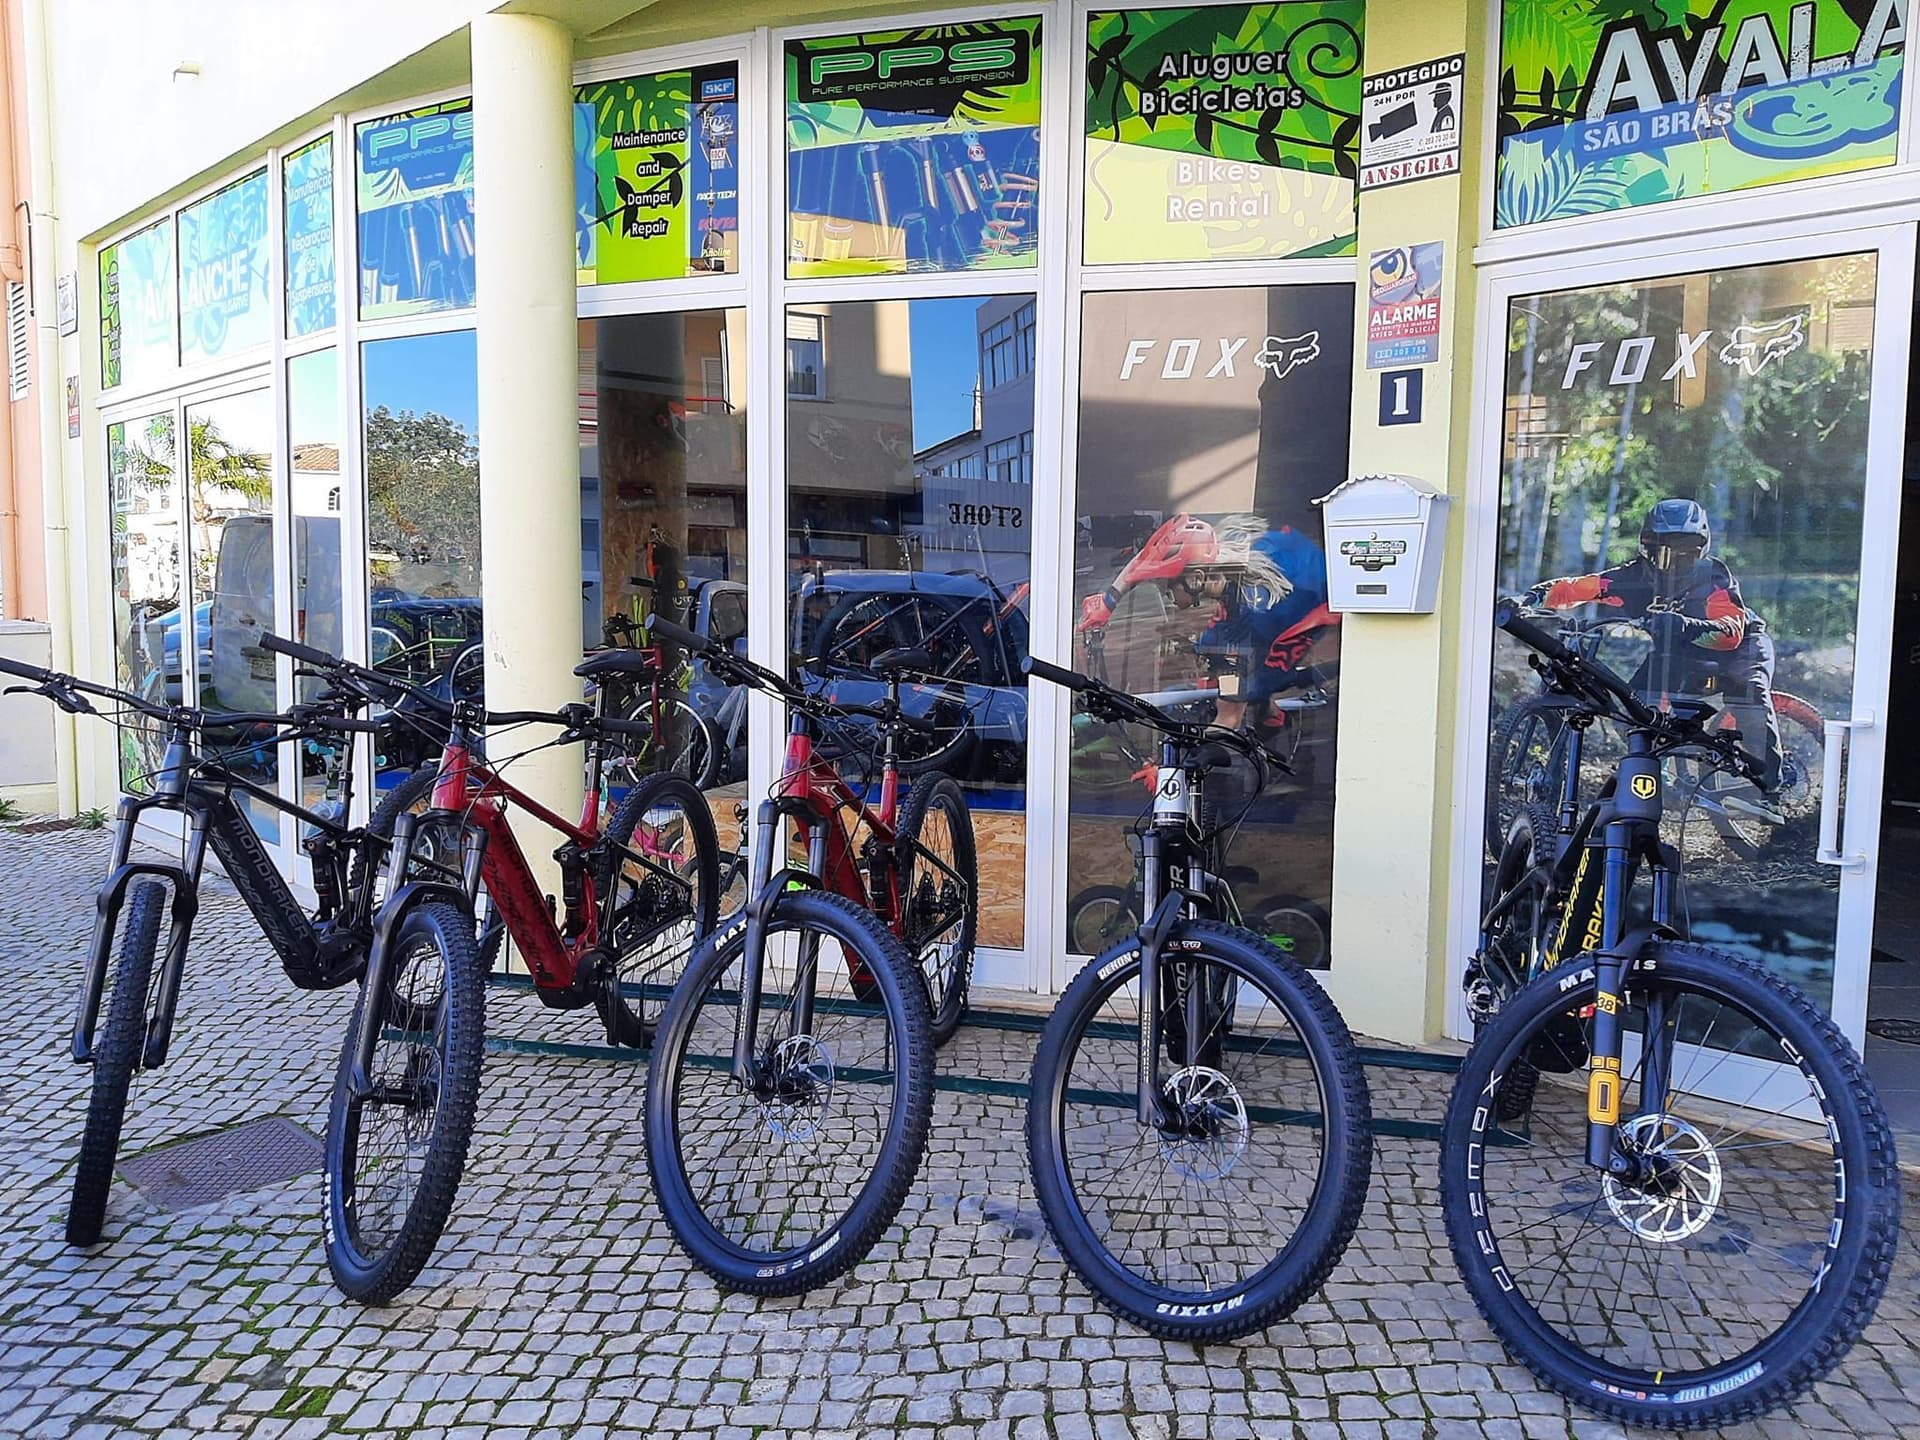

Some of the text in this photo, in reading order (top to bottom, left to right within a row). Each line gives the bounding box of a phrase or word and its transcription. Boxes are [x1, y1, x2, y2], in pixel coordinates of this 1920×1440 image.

[810, 38, 1016, 85] PPS
[1158, 52, 1289, 79] Aluguer
[705, 83, 731, 94] SKF
[812, 70, 1015, 96] PURE PERFORMANCE SUSPENSION
[1363, 58, 1462, 95] PROTEGIDO
[1141, 87, 1303, 115] Bicicletas
[1396, 90, 1415, 101] POR
[614, 130, 686, 149] Maintenance
[1583, 118, 1640, 152] SÃO
[638, 160, 660, 175] and
[1179, 161, 1262, 184] Bikes
[1363, 154, 1454, 186] ANSEGRA
[627, 191, 671, 208] Damper
[1168, 196, 1270, 219] Rental
[632, 221, 667, 237] Repair
[1371, 303, 1437, 326] ALARME
[1119, 337, 1248, 380] FOX
[1561, 330, 1714, 390] FOX
[1391, 376, 1409, 415] 1
[229, 817, 310, 940] MONDRAKER
[715, 919, 748, 951] MAX
[1560, 960, 1657, 992] MAIS
[1597, 997, 1614, 1011] 38
[324, 1172, 336, 1245] MAXXIS
[1156, 1293, 1245, 1318] MAXXIS
